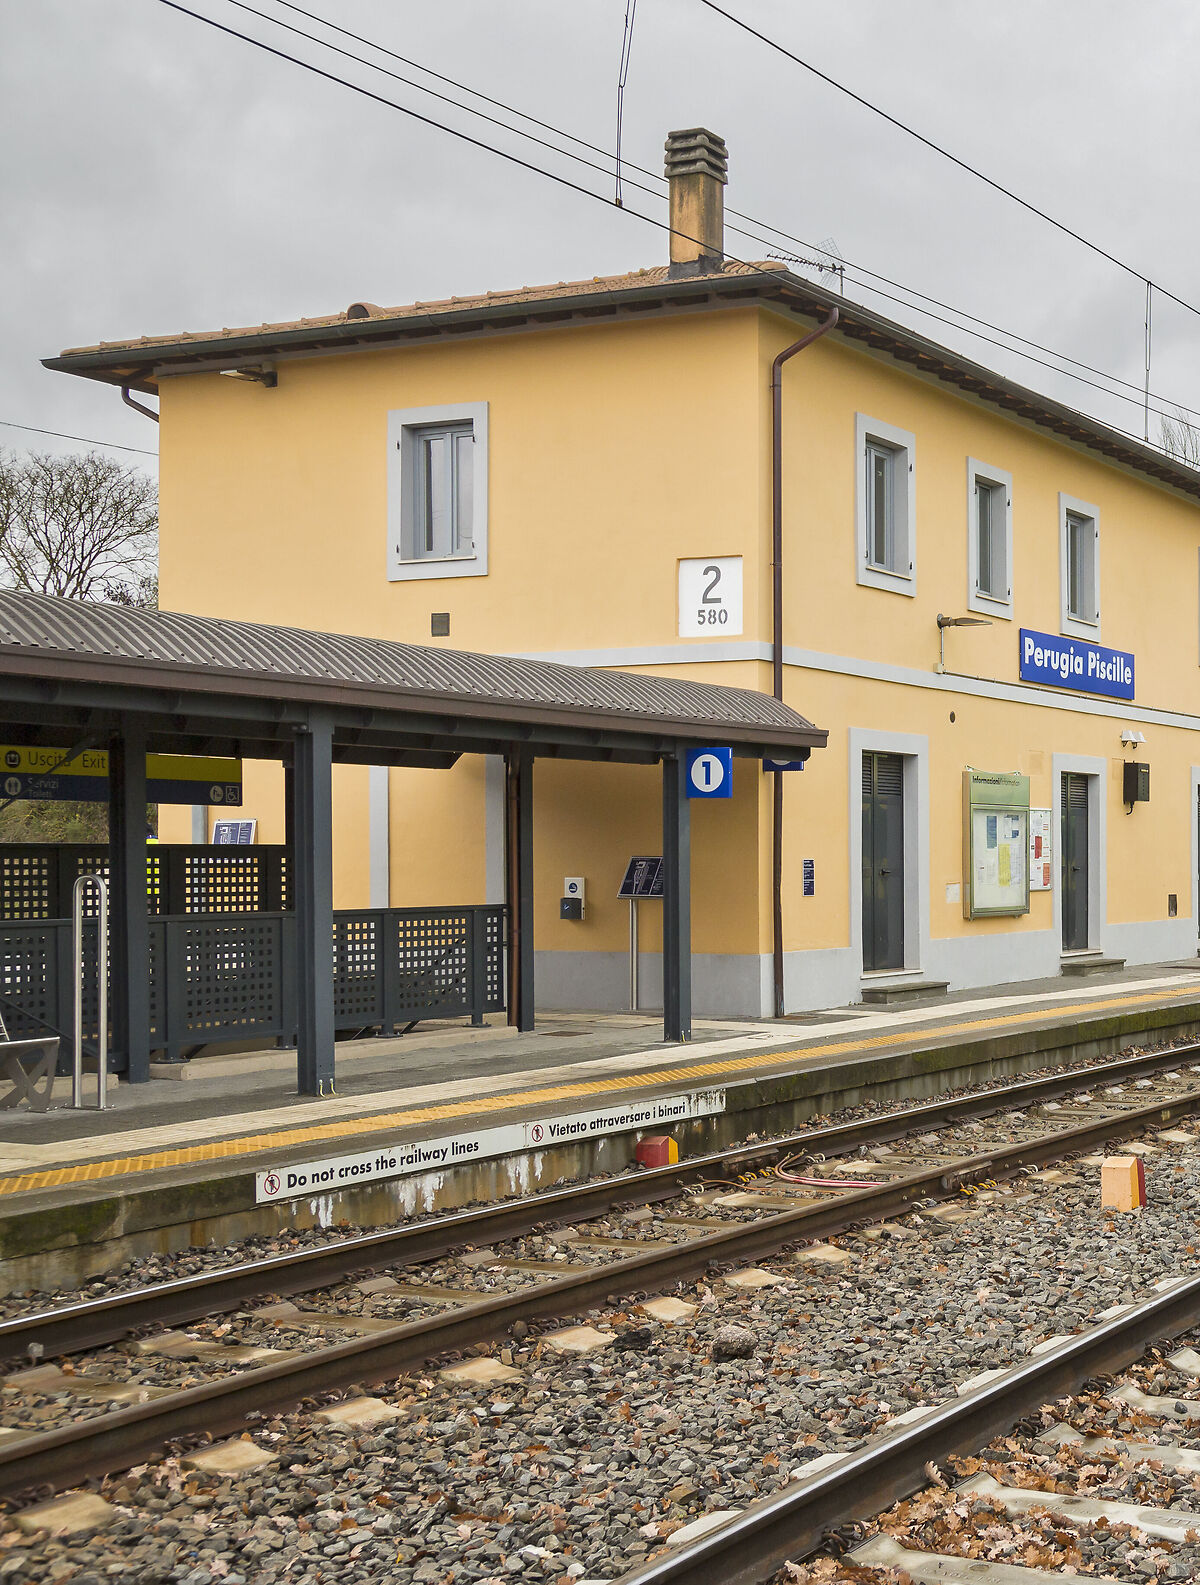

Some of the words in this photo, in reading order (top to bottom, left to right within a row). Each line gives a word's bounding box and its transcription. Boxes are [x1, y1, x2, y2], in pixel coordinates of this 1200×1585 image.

[702, 565, 722, 604] 2
[697, 608, 728, 625] 580
[1024, 636, 1084, 679] Perugia
[1087, 651, 1132, 685] Piscille
[82, 753, 106, 768] Exit
[701, 760, 711, 786] 1
[549, 1121, 587, 1137] Vietato
[589, 1111, 650, 1131] attraversare
[653, 1106, 656, 1119] i
[658, 1102, 686, 1118] binari
[287, 1173, 307, 1189] Do
[311, 1167, 335, 1184] not
[338, 1161, 372, 1179] cross
[375, 1155, 397, 1171] the
[400, 1147, 448, 1166] railway
[451, 1140, 480, 1157] lines
